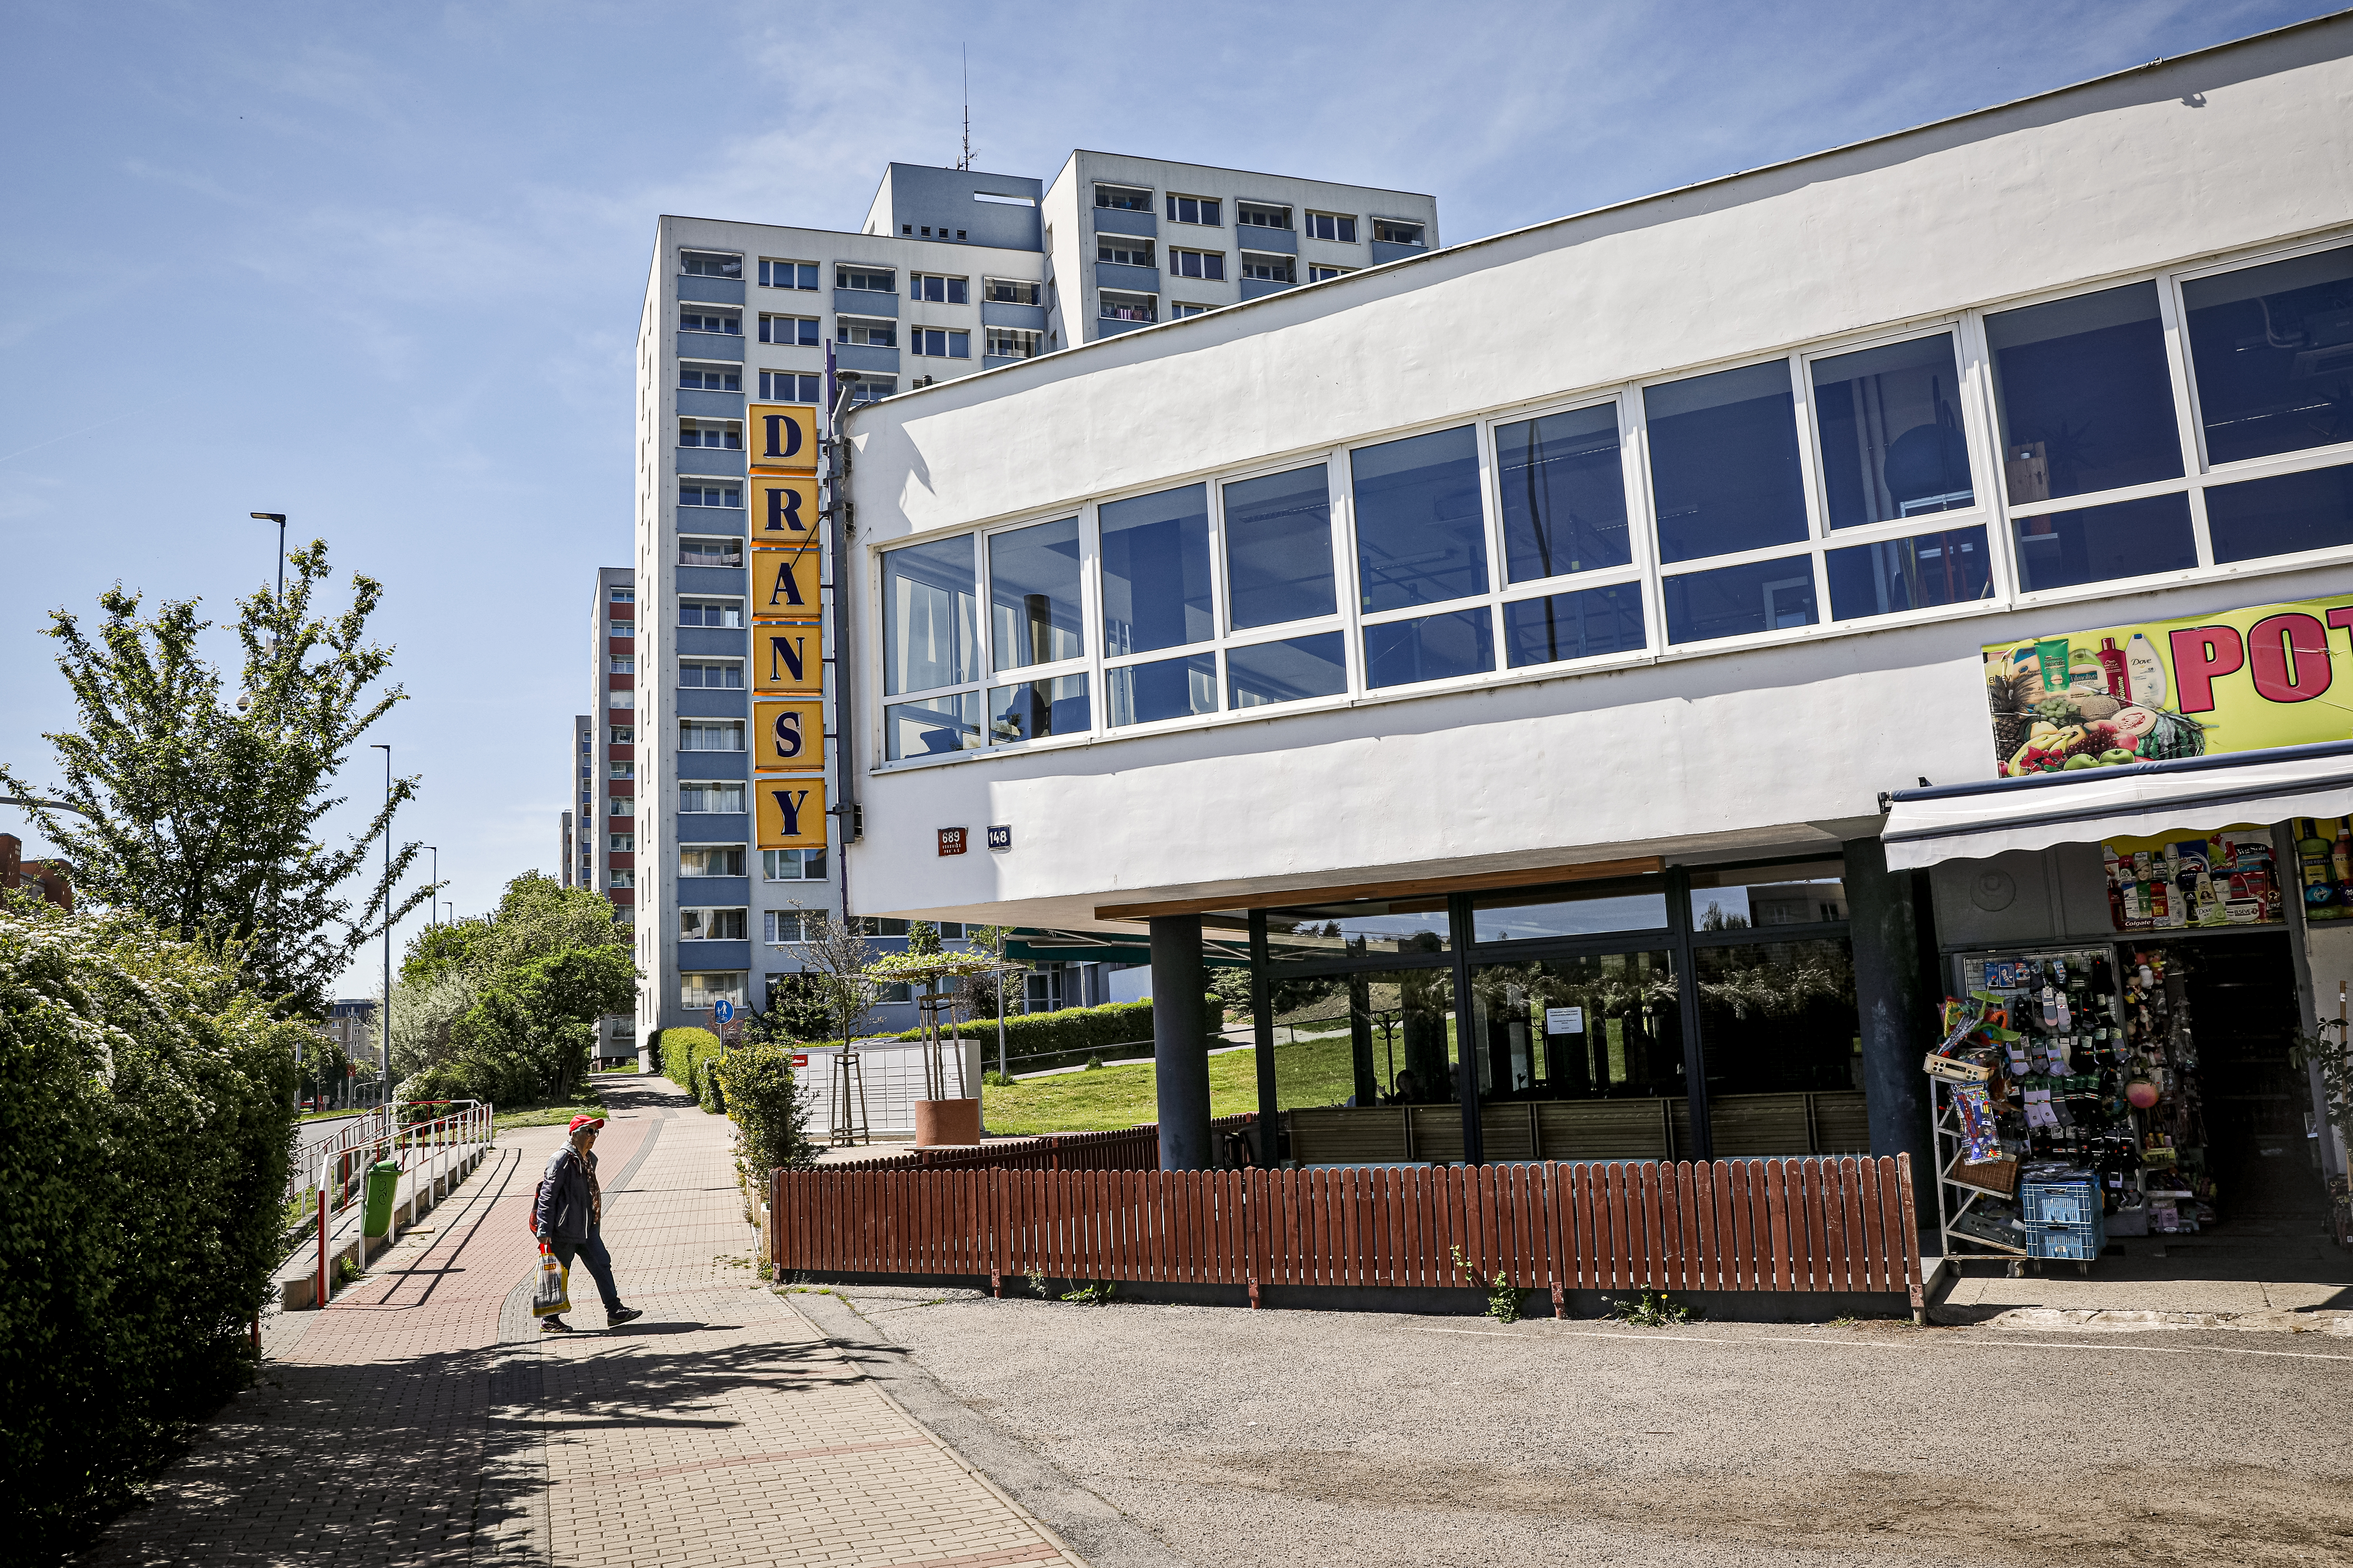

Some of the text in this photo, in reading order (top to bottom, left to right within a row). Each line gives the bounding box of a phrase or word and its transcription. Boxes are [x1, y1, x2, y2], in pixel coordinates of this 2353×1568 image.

[762, 415, 809, 836] DRANSY
[2069, 673, 2097, 681] Palmolive
[2118, 676, 2126, 700] volume
[942, 831, 960, 843] 689
[989, 831, 1007, 844] 148
[2236, 848, 2250, 856] Big
[2266, 902, 2281, 910] Lenor
